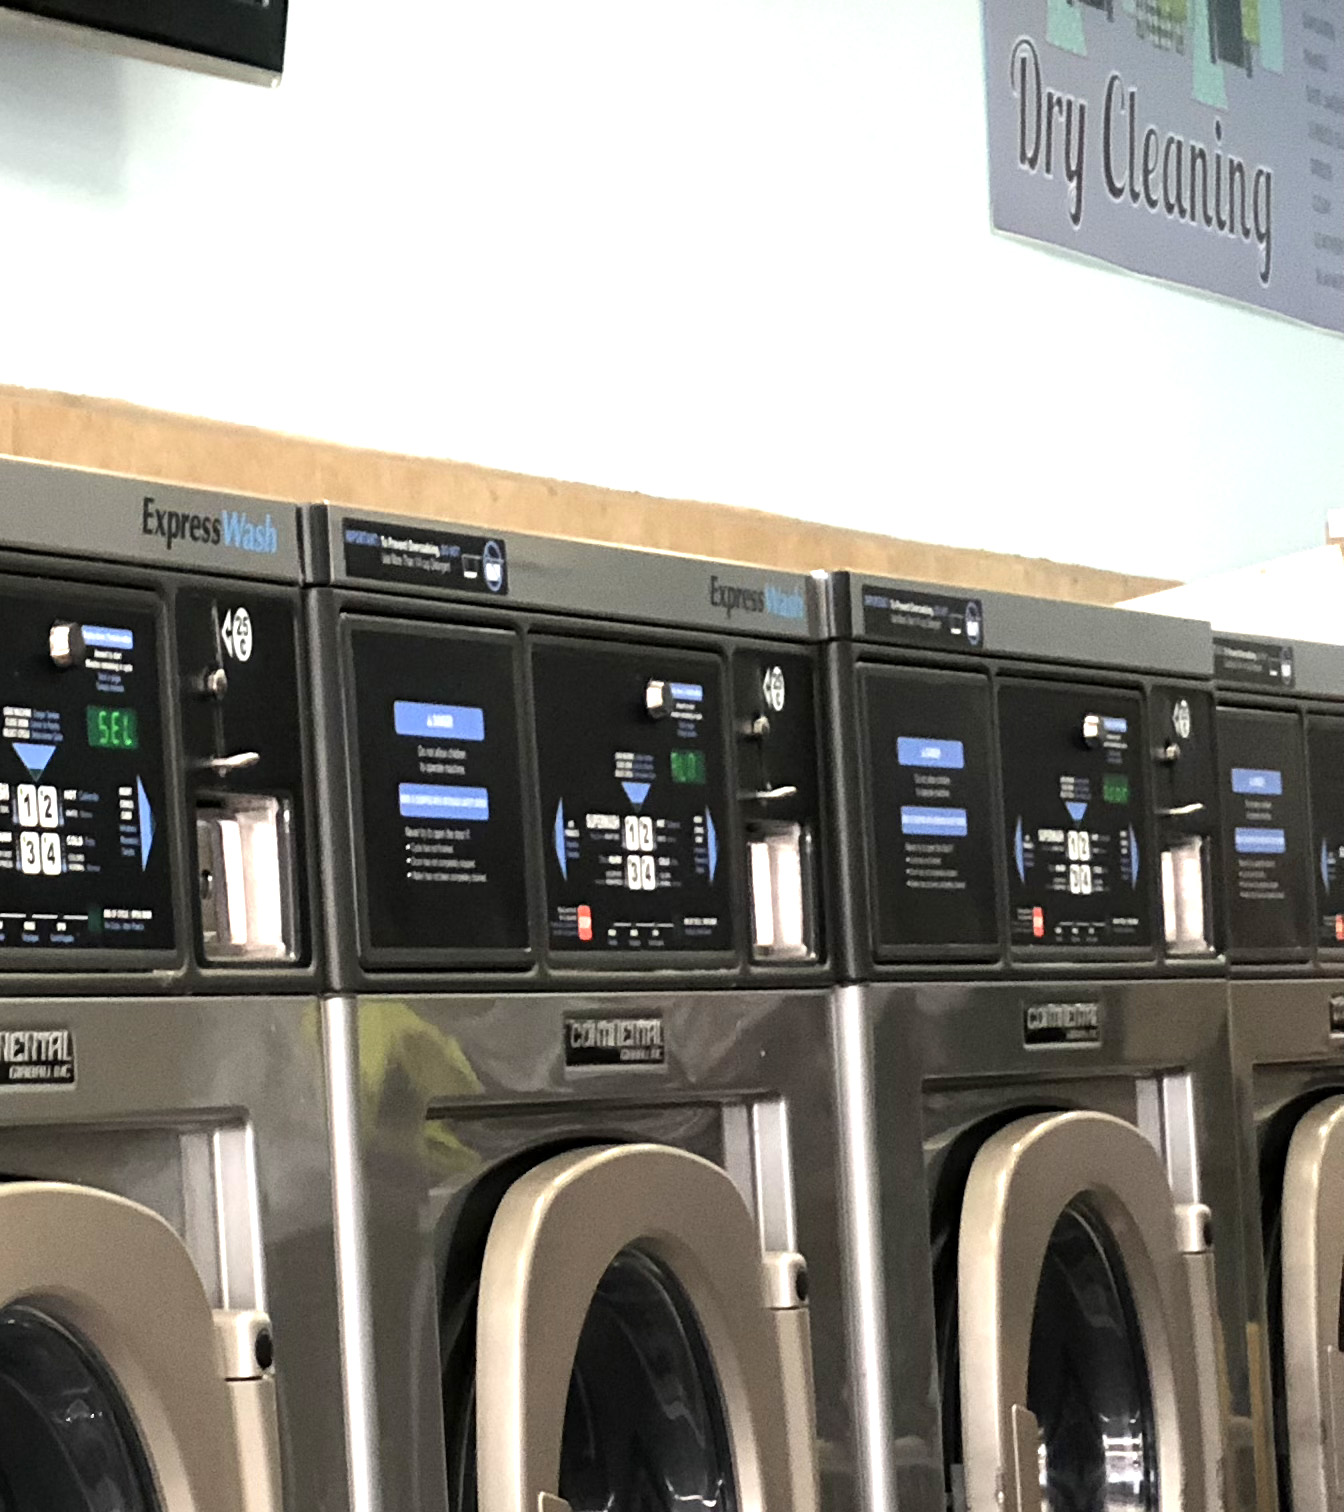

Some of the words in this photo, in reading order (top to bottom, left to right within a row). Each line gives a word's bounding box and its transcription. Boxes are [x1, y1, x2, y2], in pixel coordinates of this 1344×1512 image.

[1011, 37, 1087, 230] Dry
[1103, 71, 1273, 287] Cleaning
[141, 496, 279, 555] ExpressWash
[24, 793, 31, 818] 1
[43, 794, 53, 818] 2
[26, 840, 36, 865] 3
[47, 842, 56, 866] 4
